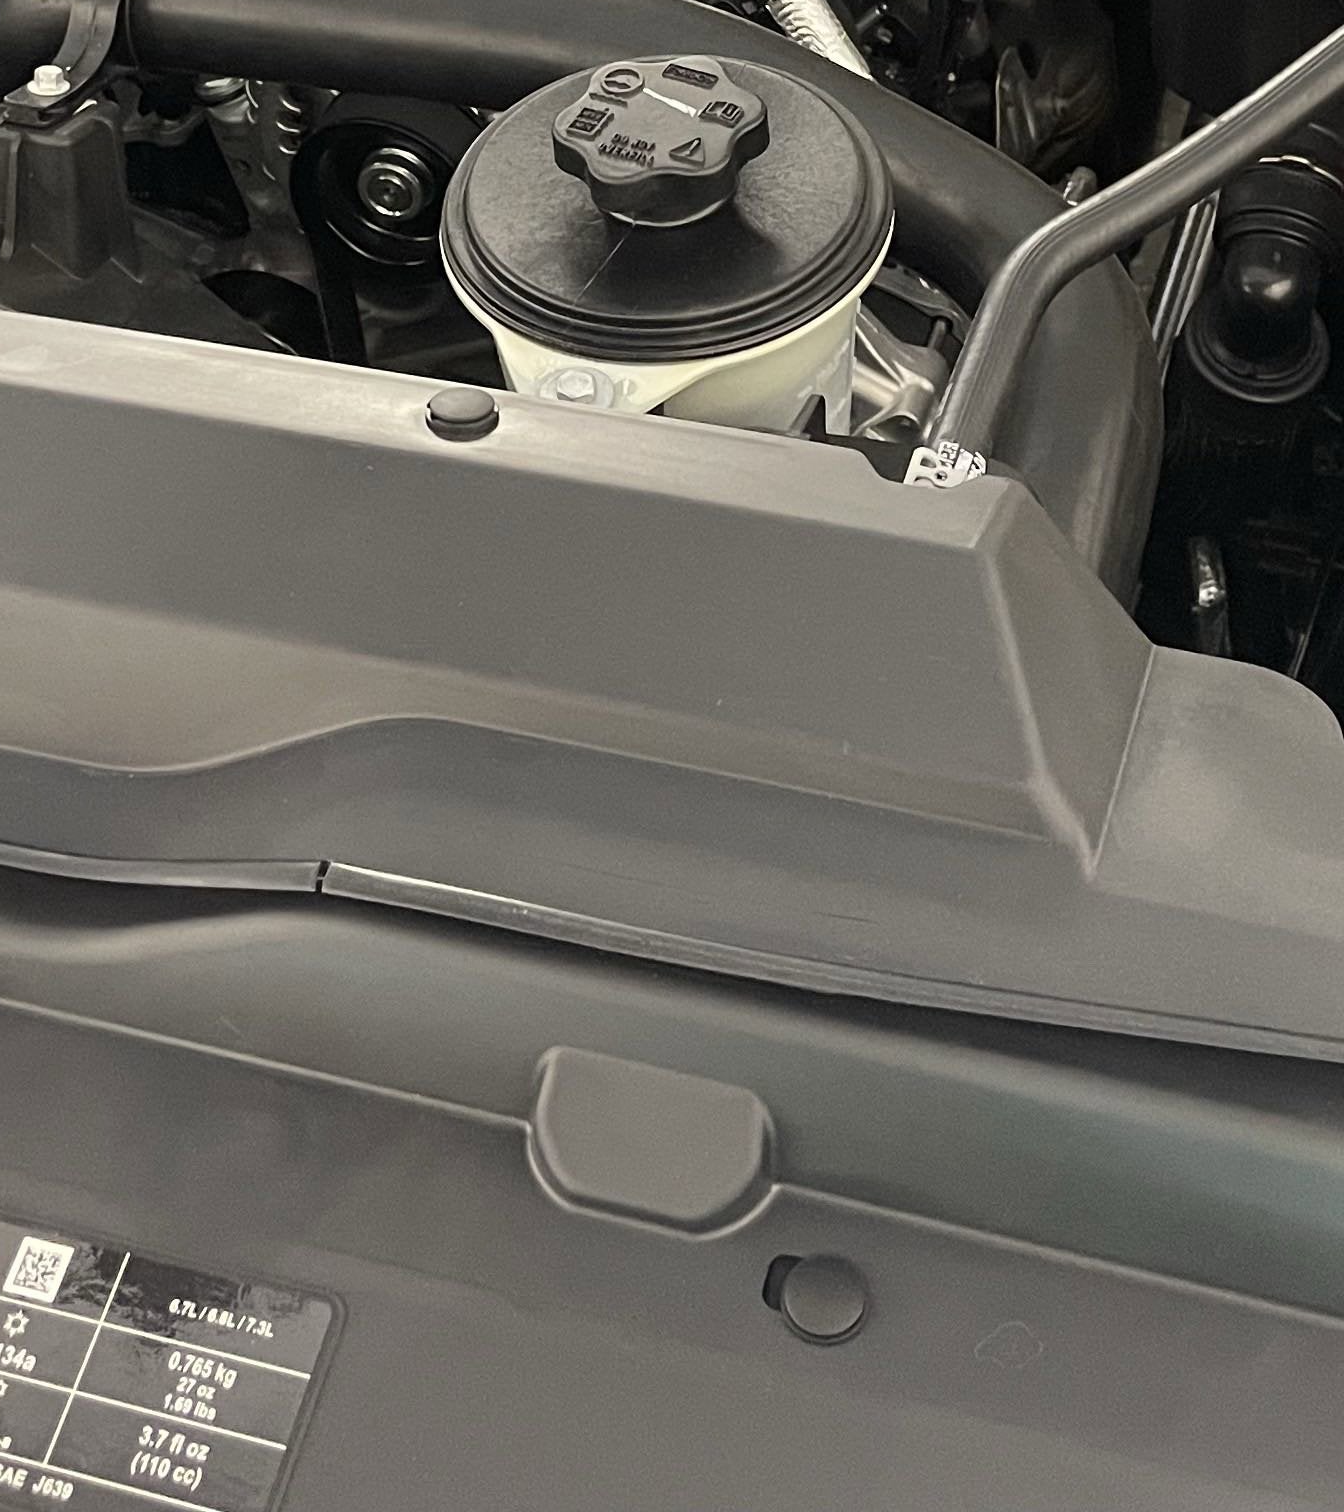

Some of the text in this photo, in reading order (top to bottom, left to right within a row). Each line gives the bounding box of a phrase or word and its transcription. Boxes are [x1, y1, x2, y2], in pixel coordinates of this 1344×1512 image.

[167, 1350, 237, 1390] 0.765 kg
[176, 1376, 216, 1397] 27 oz
[194, 1400, 217, 1422] lbs
[138, 1423, 208, 1461] 3.7 fl oz
[130, 1449, 204, 1490] (110 cc)
[32, 1473, 74, 1502] J639
